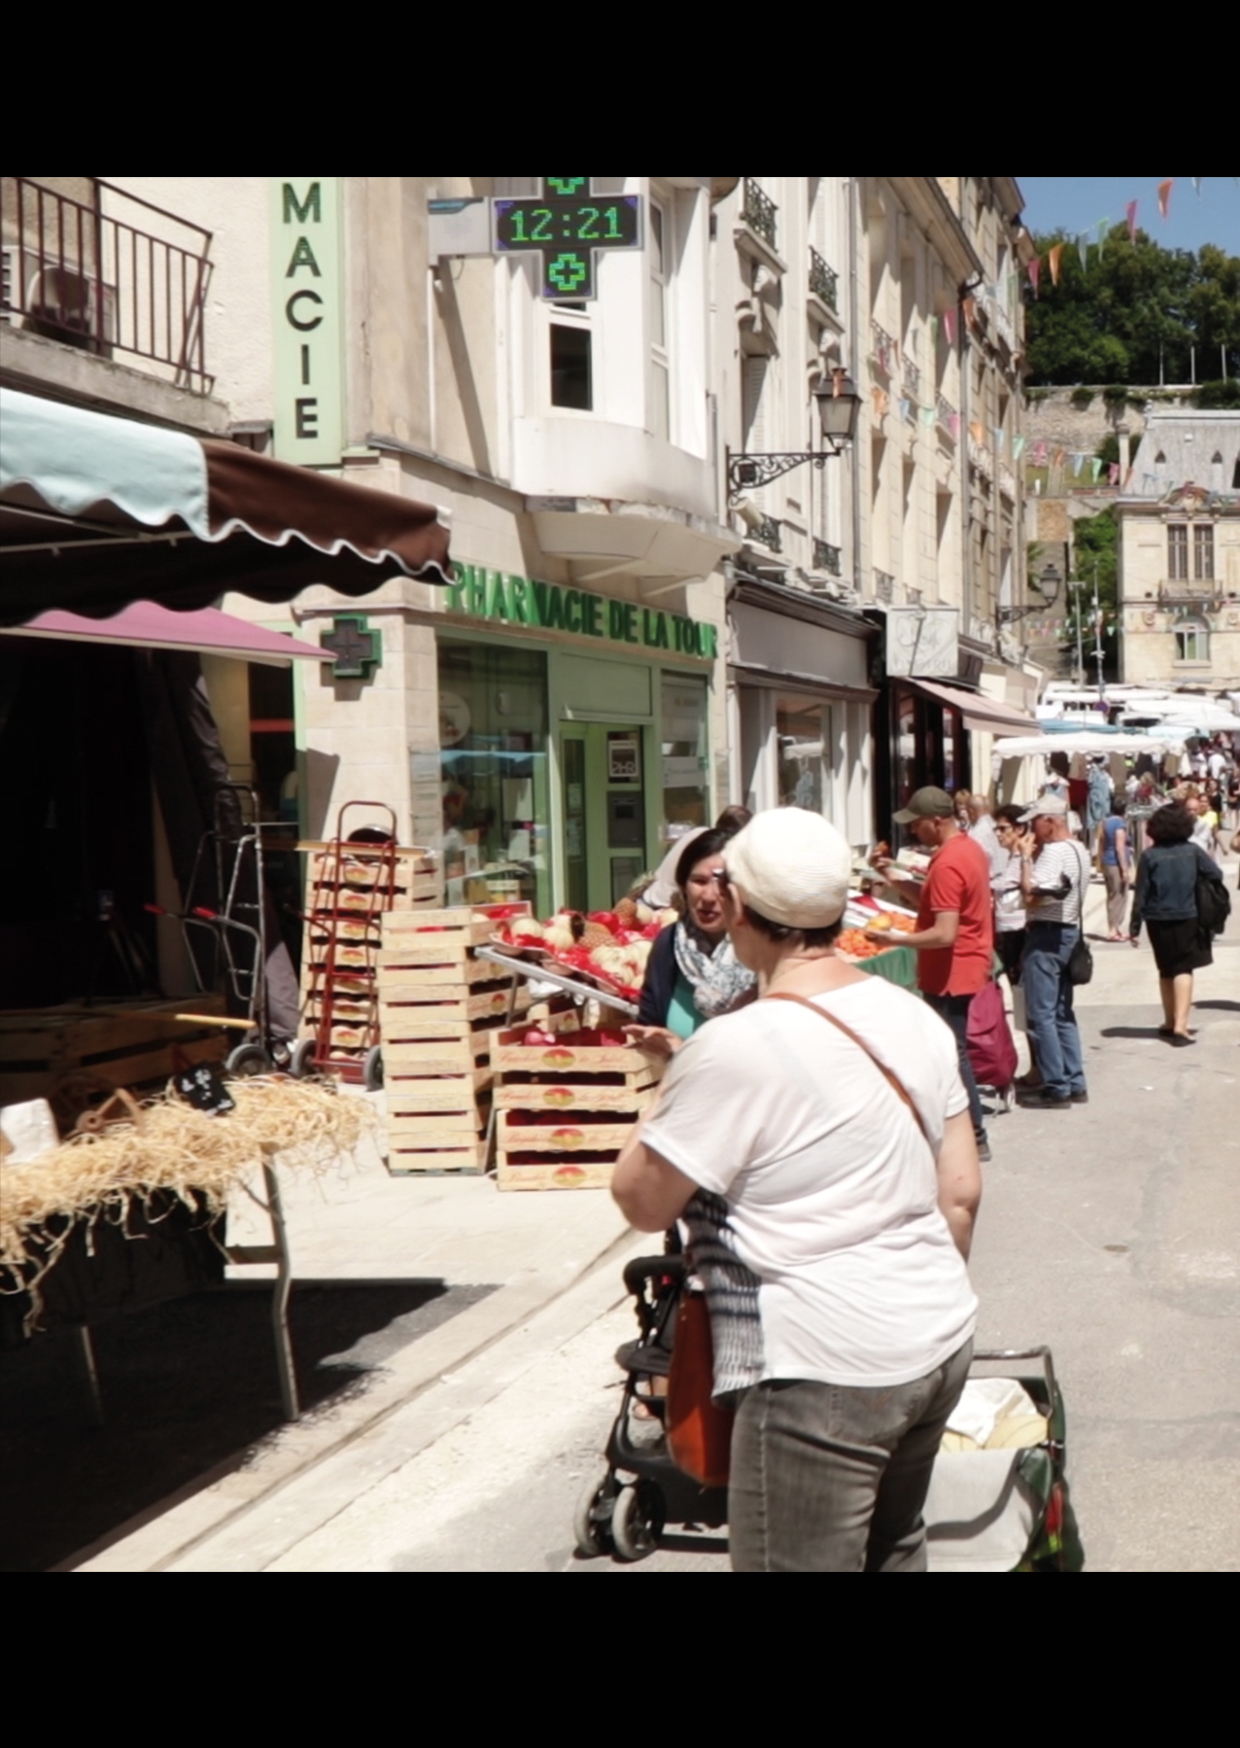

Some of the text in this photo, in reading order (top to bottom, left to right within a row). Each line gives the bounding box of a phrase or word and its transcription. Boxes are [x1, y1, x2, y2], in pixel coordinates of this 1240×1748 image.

[511, 206, 623, 242] 12:21
[281, 182, 324, 439] MACIE
[446, 561, 718, 659] PHARMACIE DE LA TOUR
